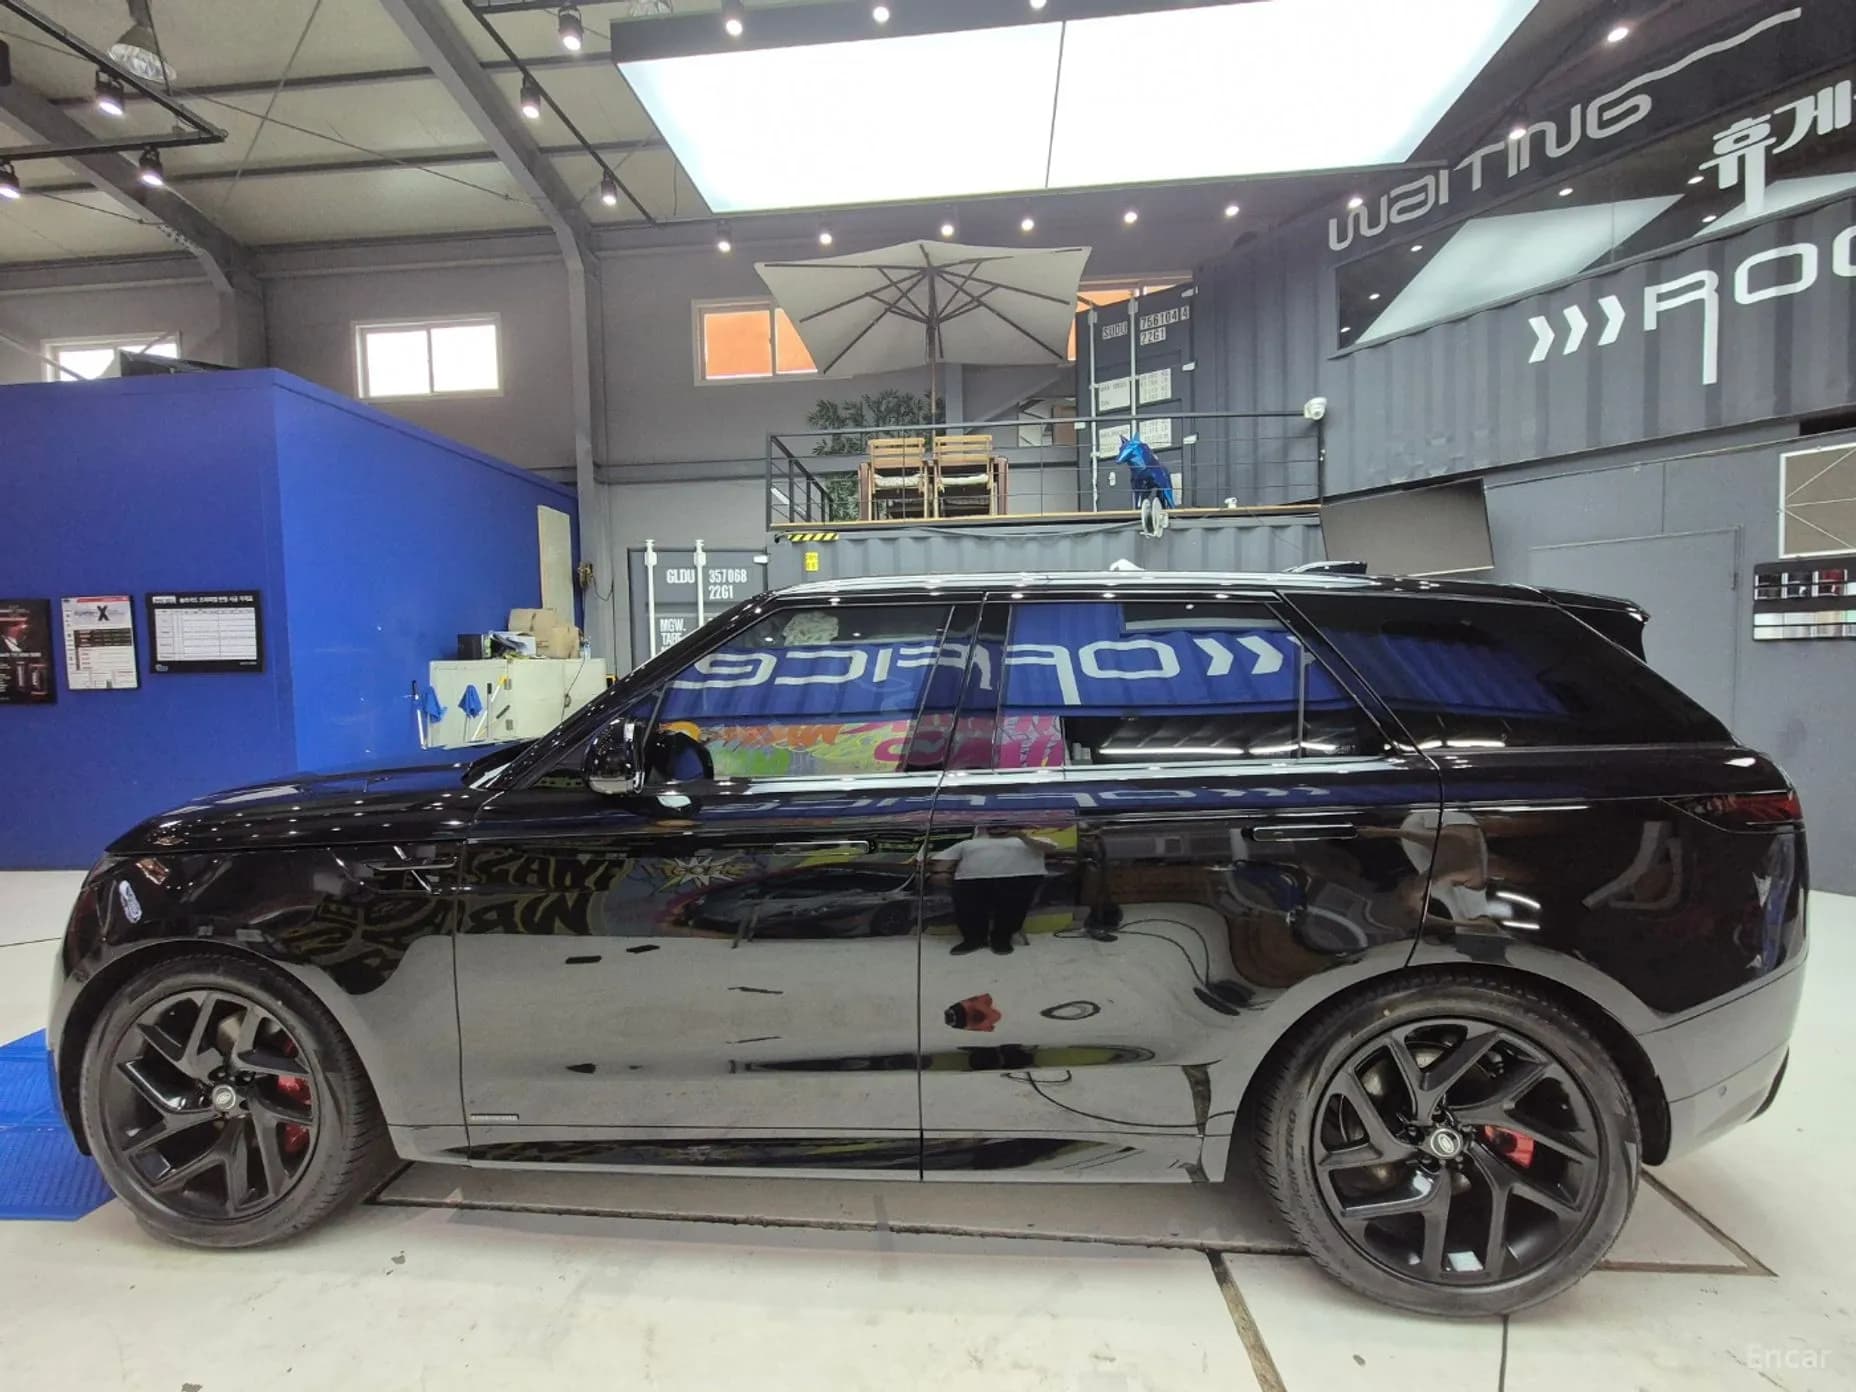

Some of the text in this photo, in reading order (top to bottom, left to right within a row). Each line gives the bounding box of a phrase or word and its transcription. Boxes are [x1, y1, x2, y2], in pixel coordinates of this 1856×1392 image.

[1699, 79, 1856, 215] 휴게
[1644, 225, 1856, 385] RO
[667, 569, 747, 584] GLDU 357068
[709, 585, 734, 600] 22G1
